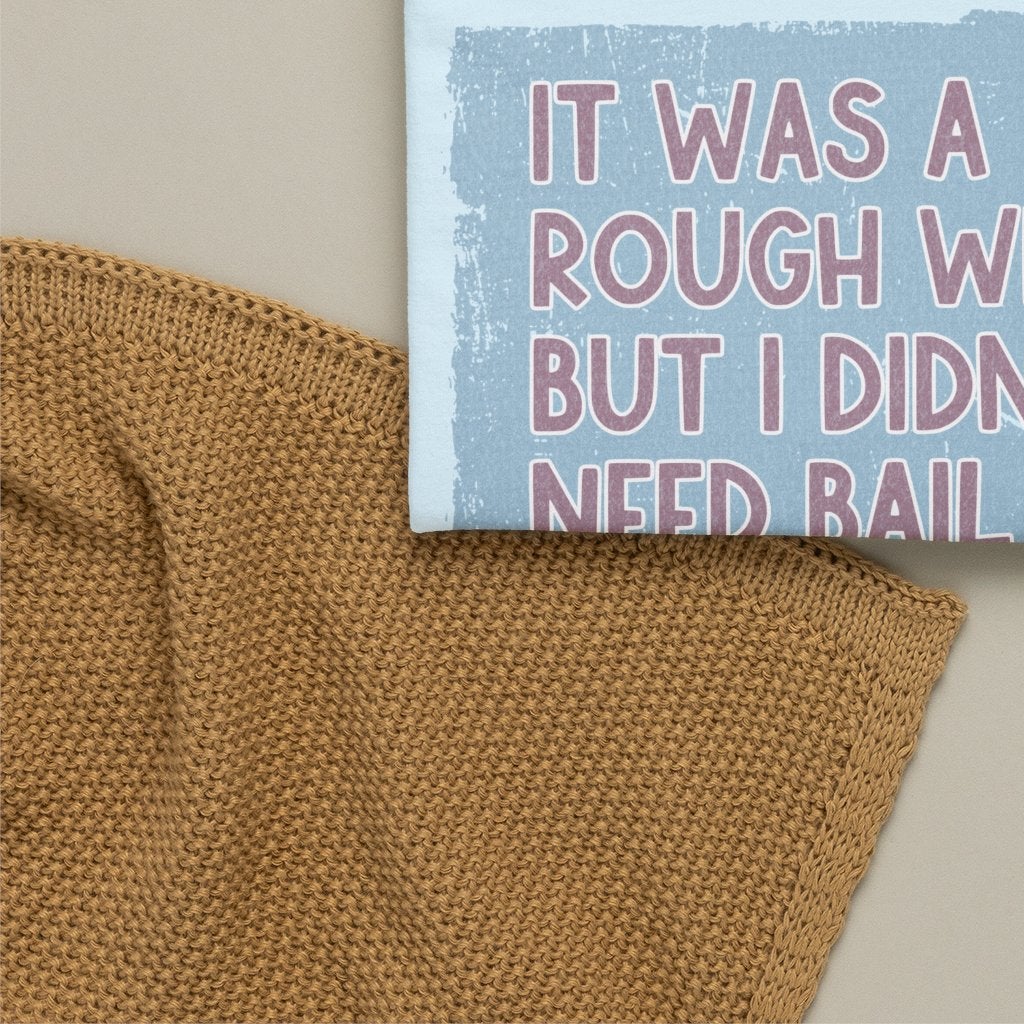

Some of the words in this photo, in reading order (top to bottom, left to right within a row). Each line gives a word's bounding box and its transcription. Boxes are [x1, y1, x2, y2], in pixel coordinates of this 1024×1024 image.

[529, 79, 618, 185] IT
[651, 78, 887, 184] WAS
[923, 76, 991, 182] A
[529, 206, 882, 312] ROUGH
[529, 333, 724, 436] BUT
[759, 333, 783, 436] I
[529, 459, 771, 535] NEED
[804, 458, 1014, 543] BAIL
